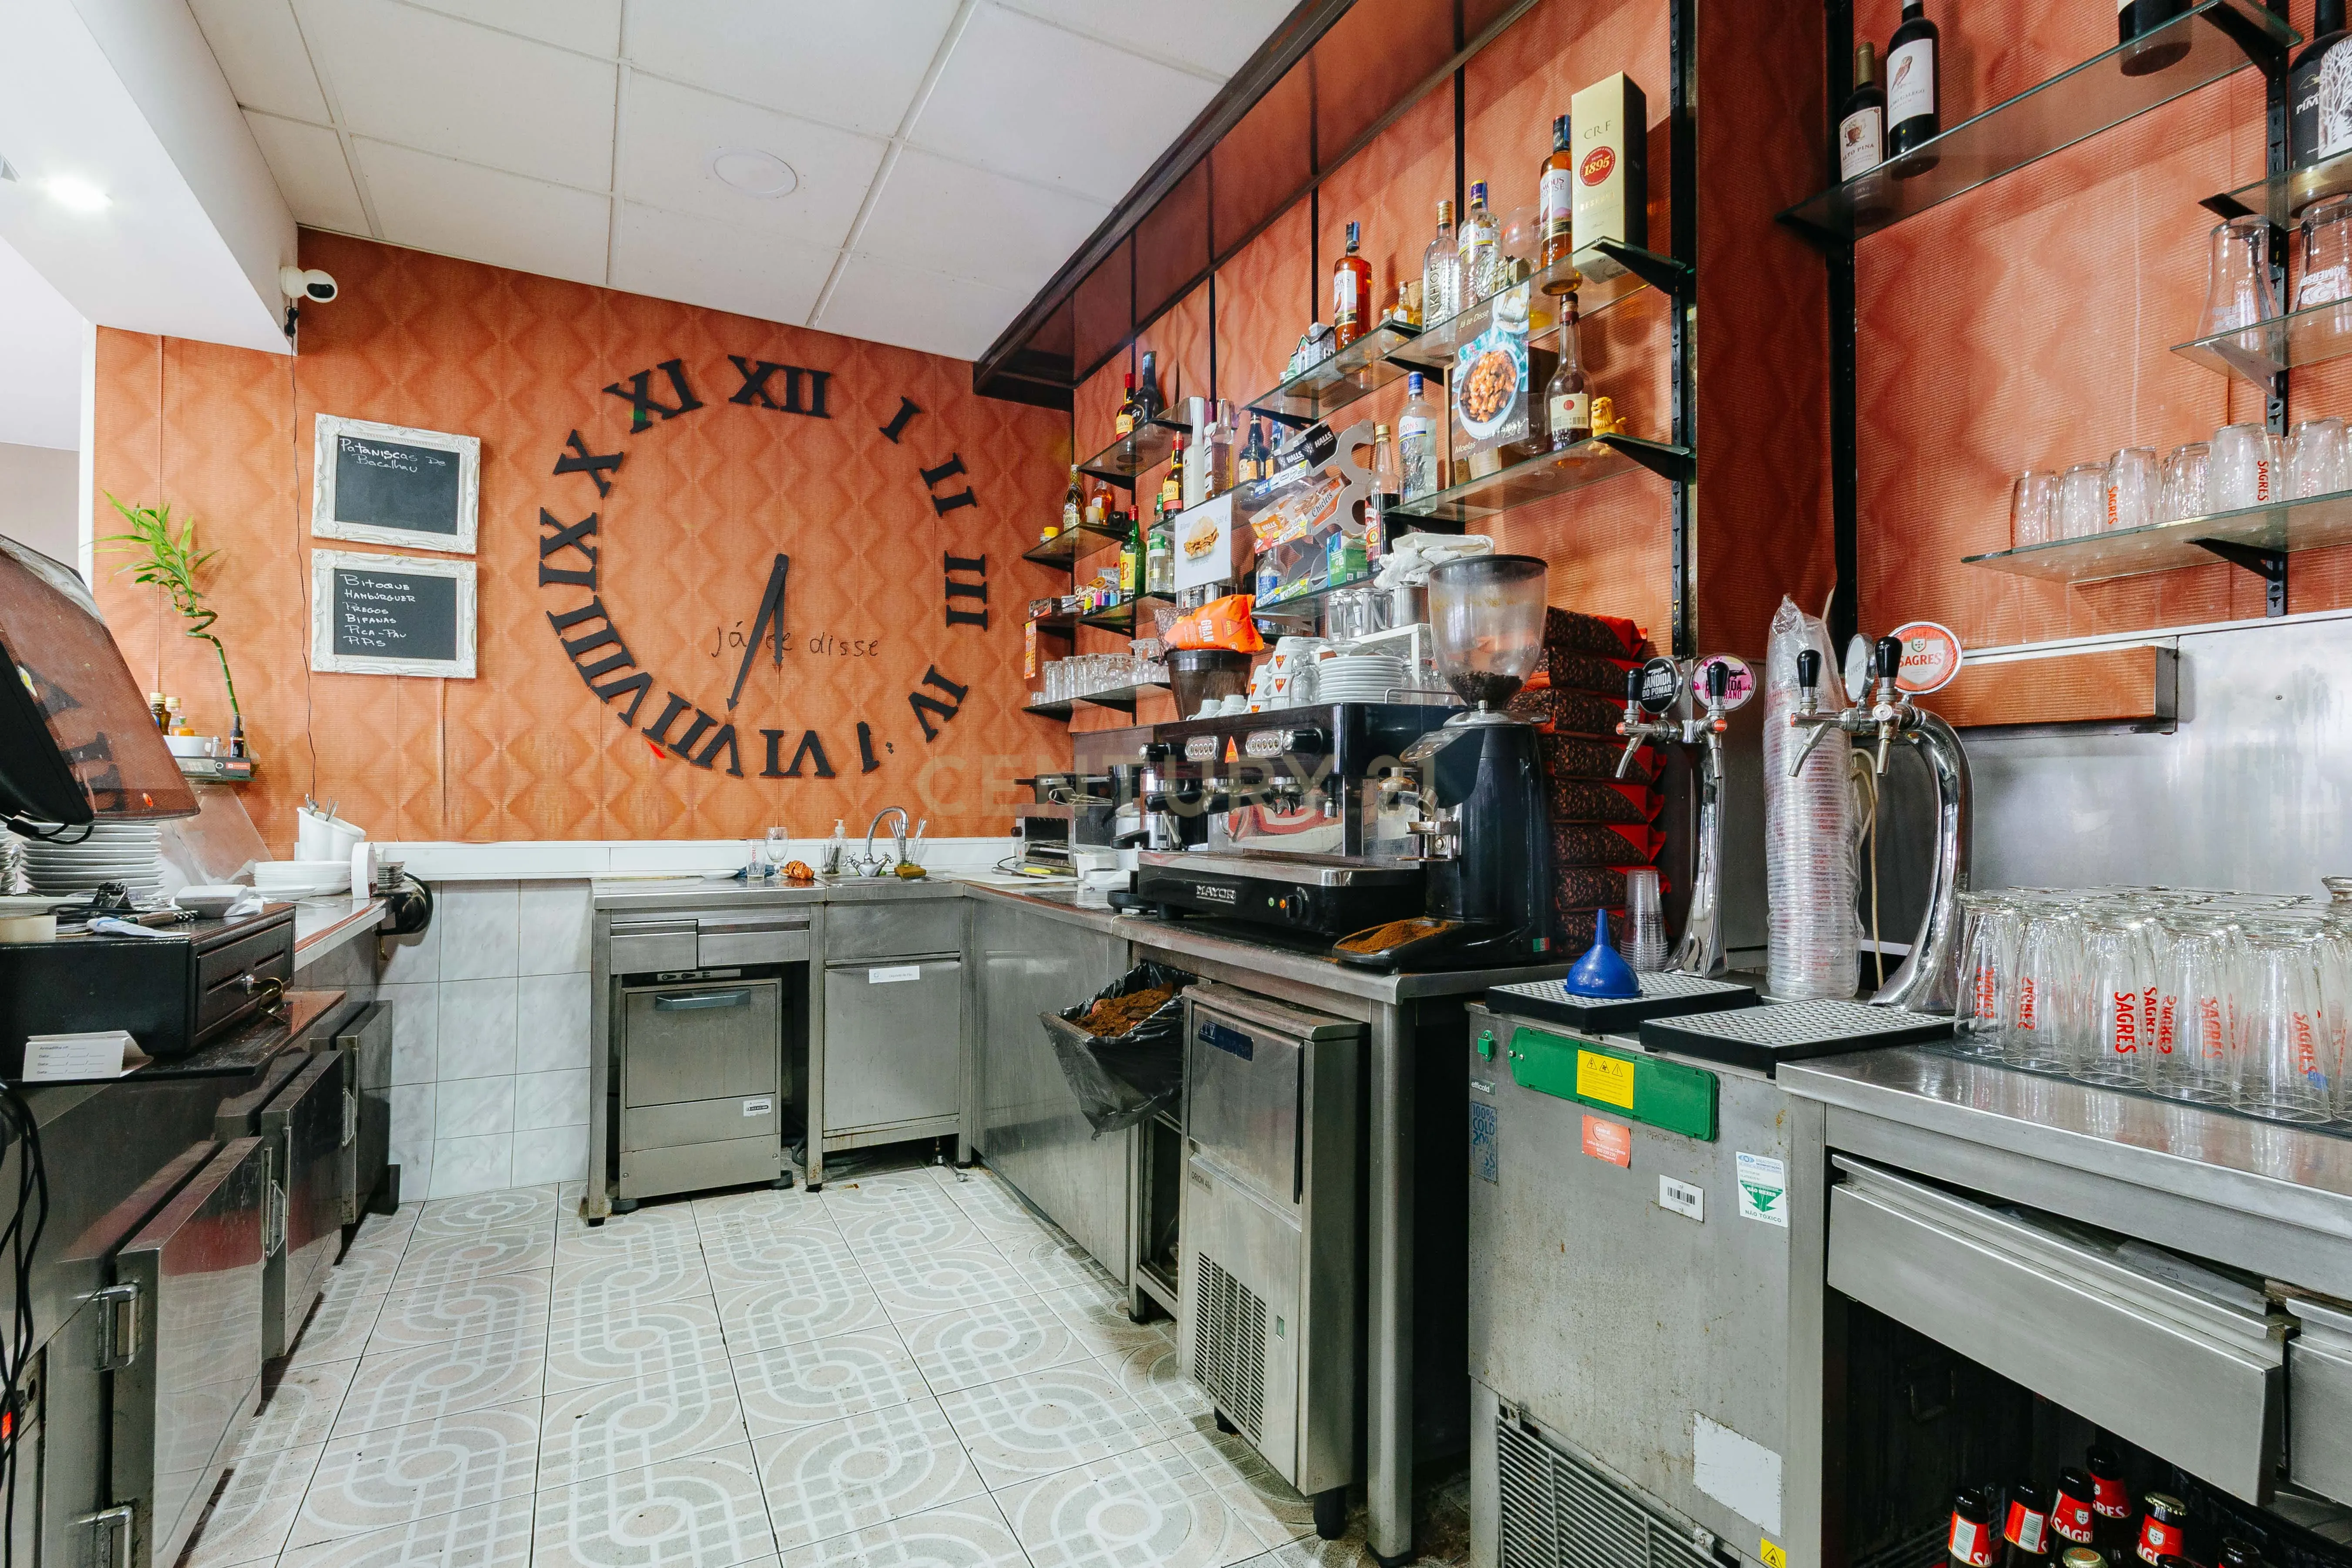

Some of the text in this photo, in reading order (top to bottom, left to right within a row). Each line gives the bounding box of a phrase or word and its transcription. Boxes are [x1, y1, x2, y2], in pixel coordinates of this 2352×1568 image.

[2295, 97, 2319, 115] PIM
[1584, 155, 1611, 177] 1895
[2299, 265, 2348, 287] SOMERSB
[1466, 316, 1473, 325] te
[1473, 309, 1489, 322] Disse
[727, 354, 832, 418] XII
[602, 358, 704, 434] XI
[1314, 431, 1333, 448] HALLS
[1454, 441, 1476, 454] Moelas
[1286, 451, 1305, 464] HALLS
[1255, 481, 1269, 493] HALLS
[2257, 460, 2269, 501] SAGRES
[1311, 491, 1333, 518] Chiclets
[2107, 485, 2118, 525] SAGRES
[1261, 521, 1278, 532] HALLS
[1283, 585, 1301, 598] Chiclets
[1201, 619, 1215, 643] GRAN
[809, 631, 879, 657] disse
[1899, 653, 1941, 667] SAGRES
[1642, 672, 1672, 690] BANDIDA
[1642, 685, 1672, 697] DO POMAR
[2114, 991, 2137, 1054] SAGRES
[2293, 1011, 2318, 1074] SAGRES
[1471, 1081, 1490, 1093] efficold
[1472, 1104, 1495, 1123] 100%
[1473, 1117, 1495, 1136] COLD
[1191, 1171, 1204, 1185] ORION
[1759, 1189, 1777, 1197] MEXER
[2054, 1516, 2093, 1543] SAGR
